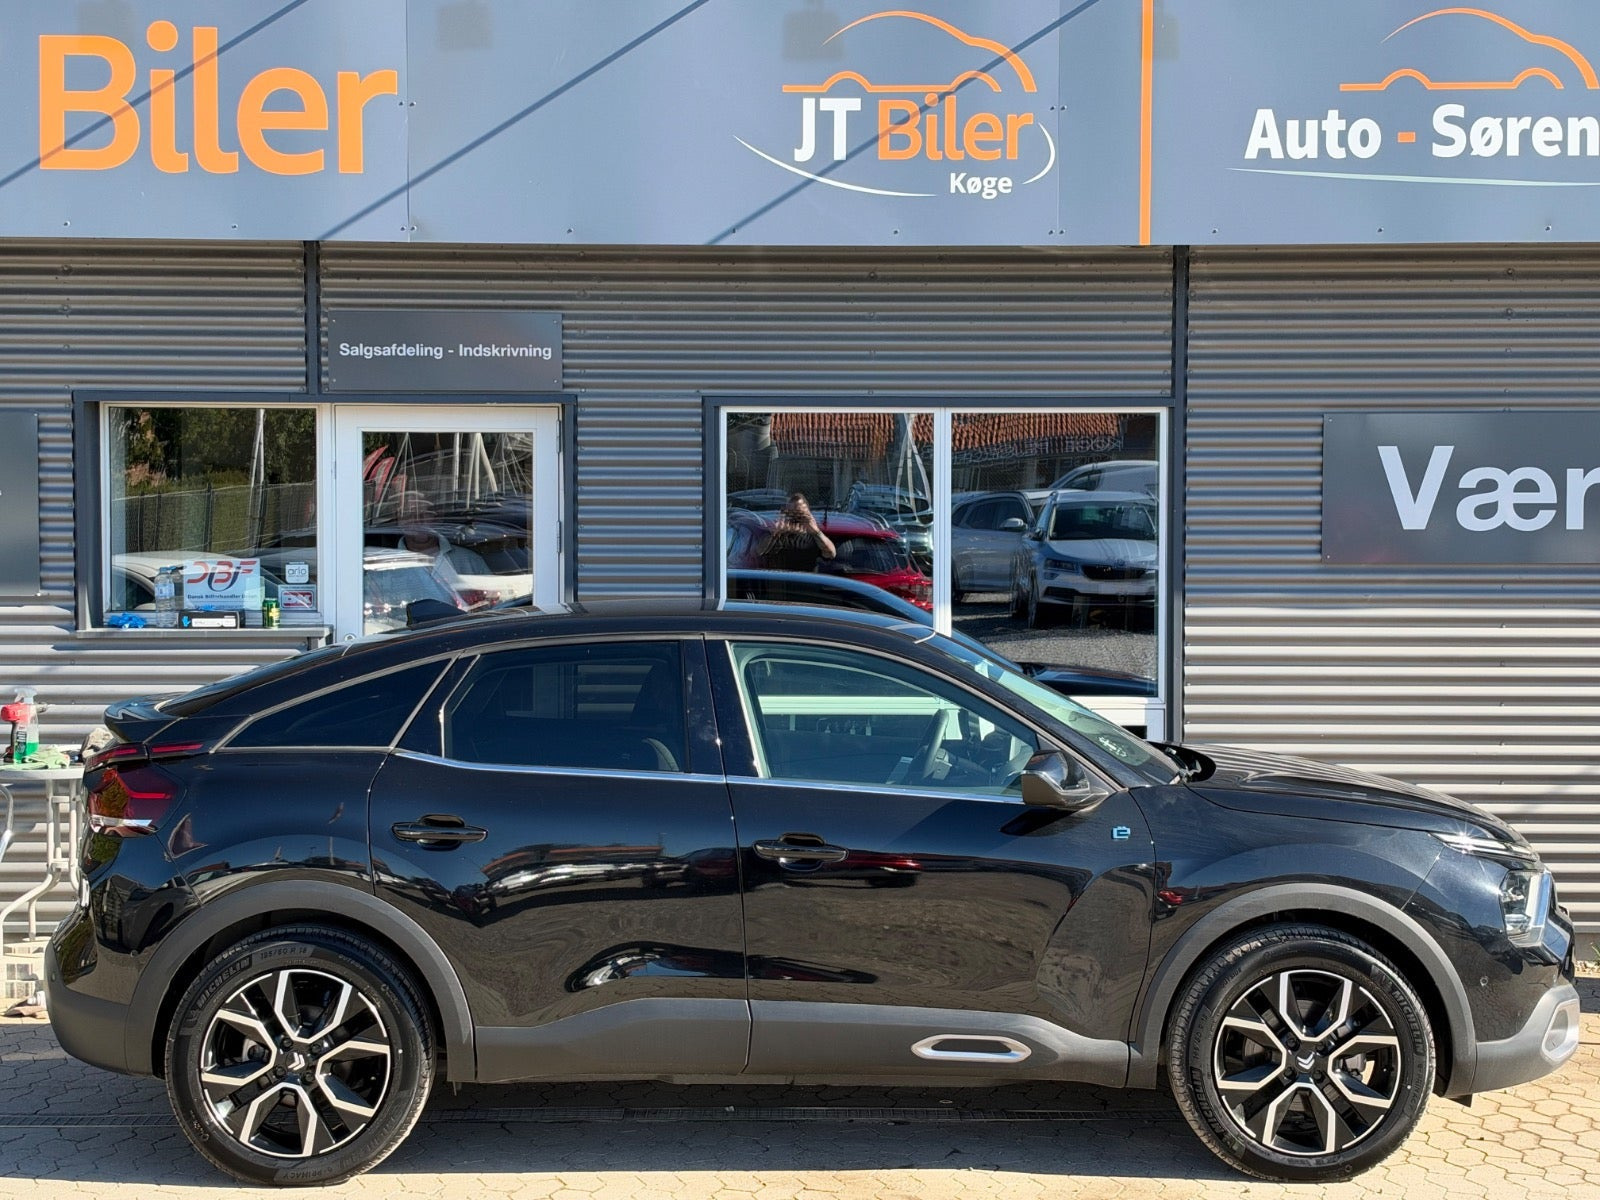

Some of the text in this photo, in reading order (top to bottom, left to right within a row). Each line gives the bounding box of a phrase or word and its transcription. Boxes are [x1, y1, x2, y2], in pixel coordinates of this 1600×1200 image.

[39, 20, 398, 175] Biler
[793, 93, 1034, 162] JT Biler
[1244, 108, 1382, 160] Auto
[1432, 103, 1600, 159] Søren
[949, 172, 1013, 200] Køge
[339, 342, 443, 360] Salgsafdeling
[458, 343, 553, 361] Indskrivning
[1377, 445, 1600, 532] Vær
[198, 957, 251, 1009] MICHELIN
[1391, 990, 1426, 1056] MICHELIN
[1191, 1067, 1224, 1140] MICHELIN
